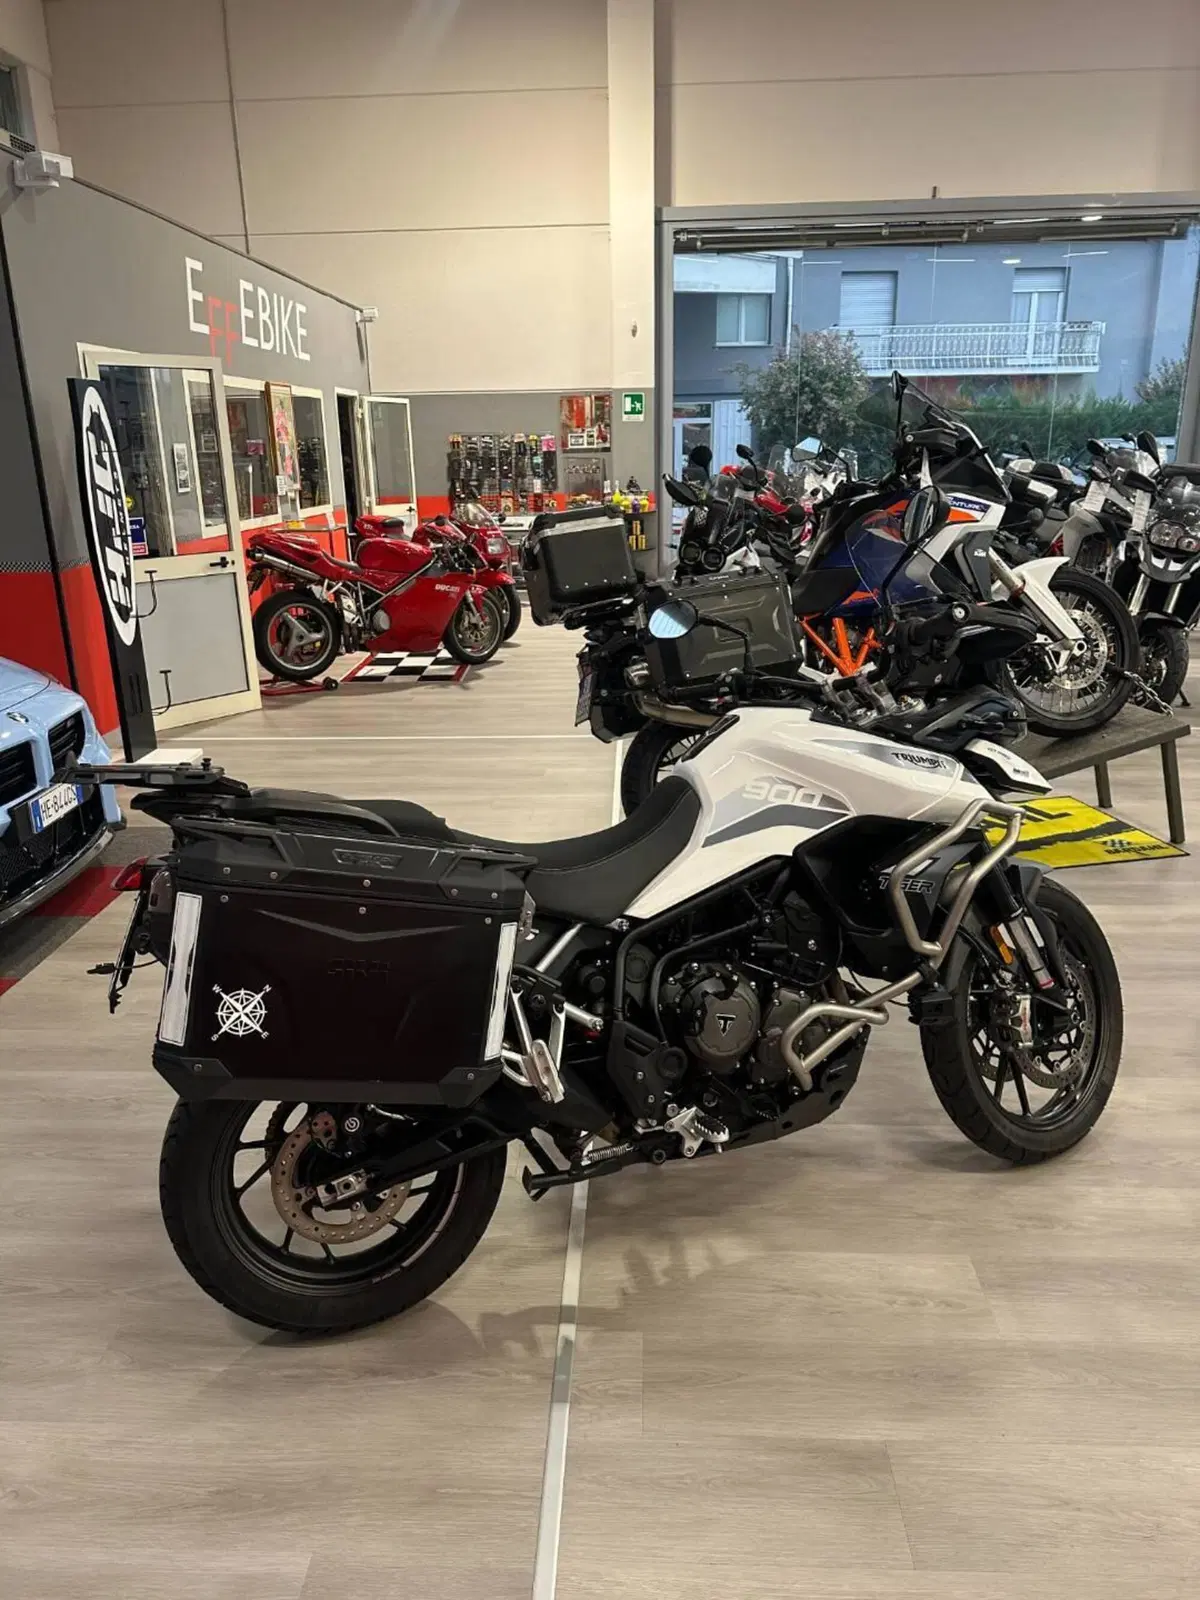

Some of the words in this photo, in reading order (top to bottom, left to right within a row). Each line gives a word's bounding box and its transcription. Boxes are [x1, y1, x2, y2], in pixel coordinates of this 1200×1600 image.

[185, 256, 311, 367] EFFEBIKE
[87, 429, 133, 611] HJC
[891, 752, 947, 769] TRIUMPH
[741, 781, 824, 808] 900
[878, 875, 936, 894] TGER
